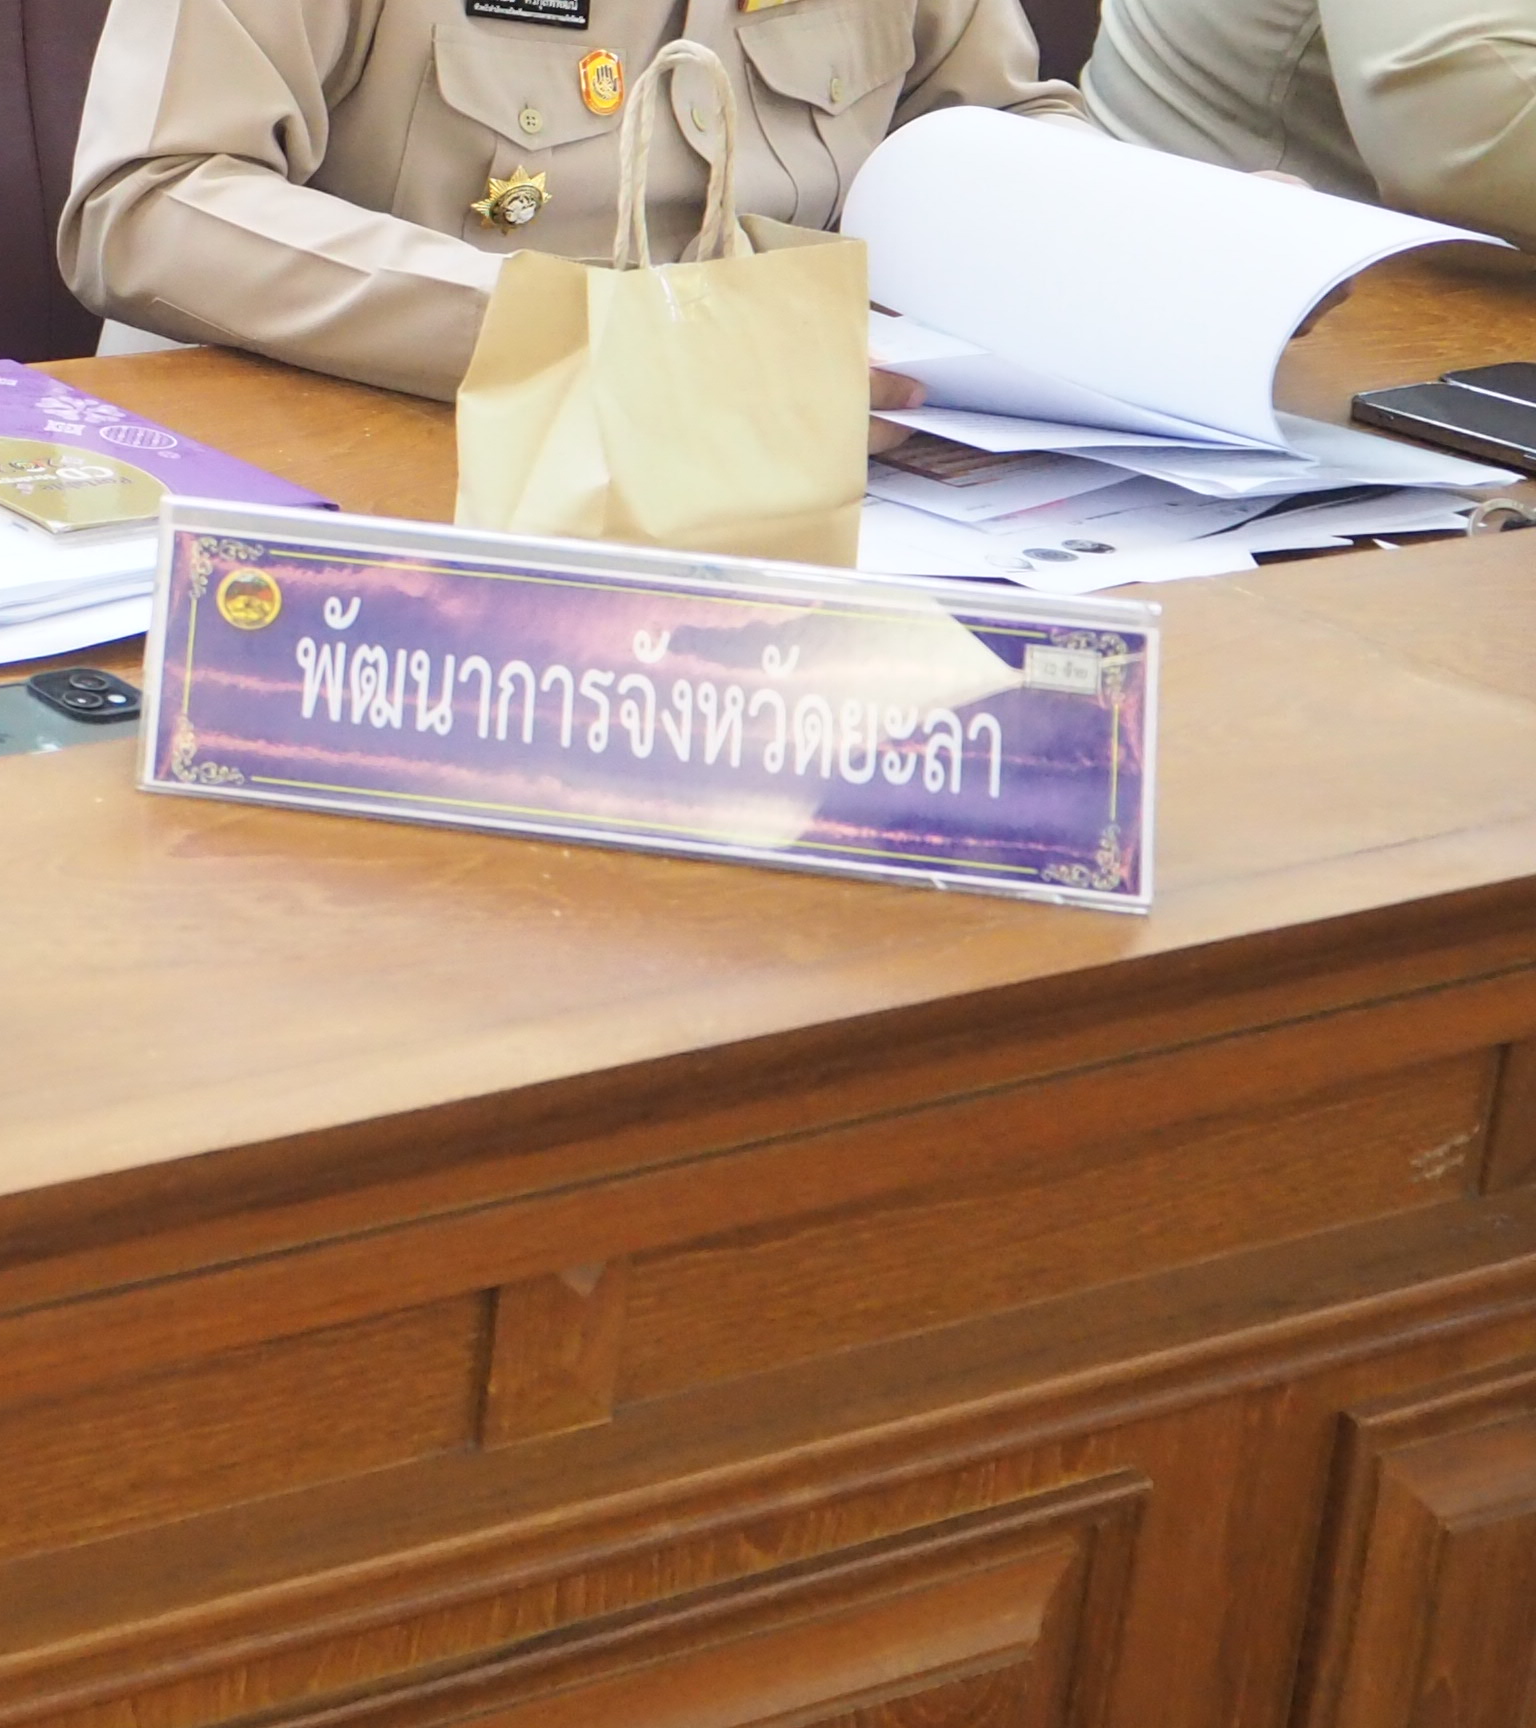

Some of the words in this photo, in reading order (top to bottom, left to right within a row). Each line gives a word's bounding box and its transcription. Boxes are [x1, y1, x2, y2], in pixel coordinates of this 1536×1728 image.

[294, 596, 1003, 799] พัฒนาการจังหวัดยะลา
